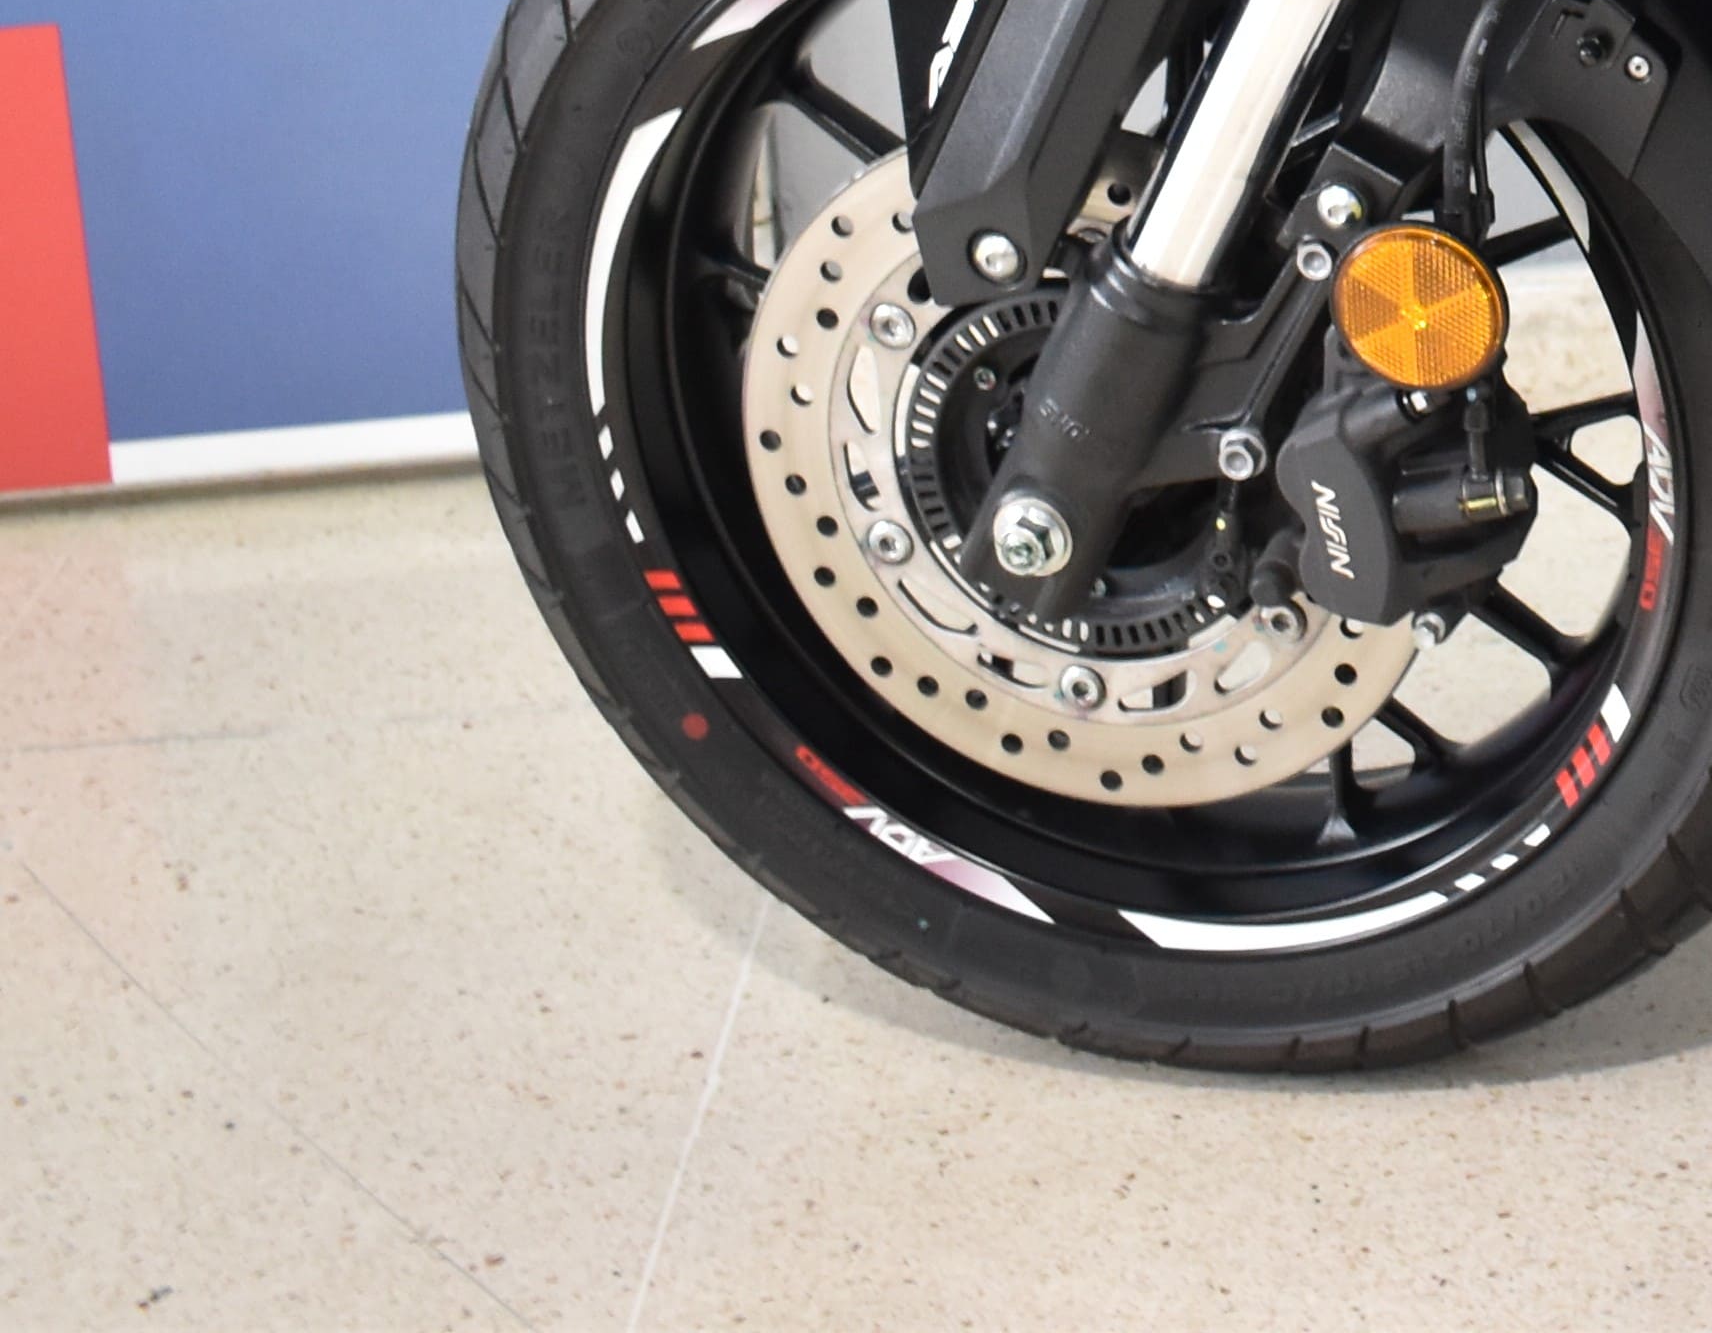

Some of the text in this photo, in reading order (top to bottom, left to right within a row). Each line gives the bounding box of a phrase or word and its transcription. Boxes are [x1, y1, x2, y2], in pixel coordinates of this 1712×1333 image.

[1310, 479, 1355, 580] NISSIN
[1642, 420, 1675, 547] ADV
[842, 806, 958, 865] ADV
